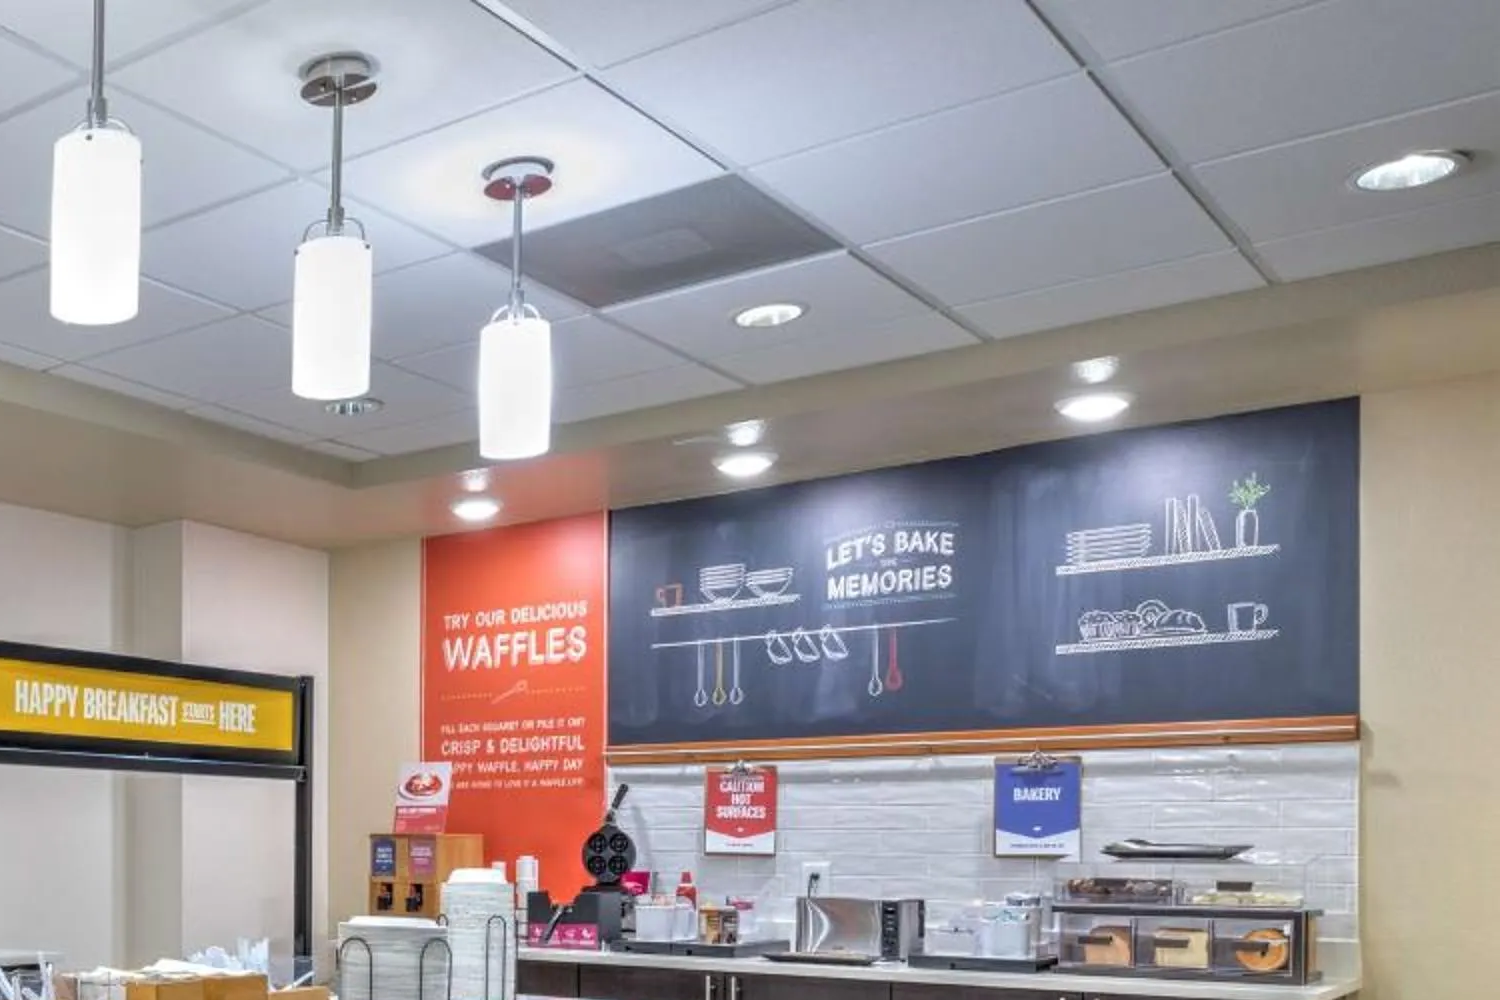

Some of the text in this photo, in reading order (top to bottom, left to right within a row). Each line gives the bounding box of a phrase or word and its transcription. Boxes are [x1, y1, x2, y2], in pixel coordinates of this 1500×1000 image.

[827, 530, 956, 570] LET'S BAKE
[827, 564, 952, 601] MEMORIES
[444, 600, 588, 630] TRY OUR DELICIOUS
[442, 625, 587, 672] WAFFLES
[15, 680, 79, 719] HAPPY
[83, 687, 179, 728] BREAKFAST
[219, 700, 257, 733] HERE
[441, 735, 585, 757] CRISP & DELIGHTFUL
[524, 759, 559, 773] HAPPY
[563, 758, 584, 771] DAY
[719, 781, 765, 793] CAUTION
[1013, 787, 1062, 801] BAKERY
[731, 793, 752, 805] HOT
[716, 805, 767, 819] SURFACES
